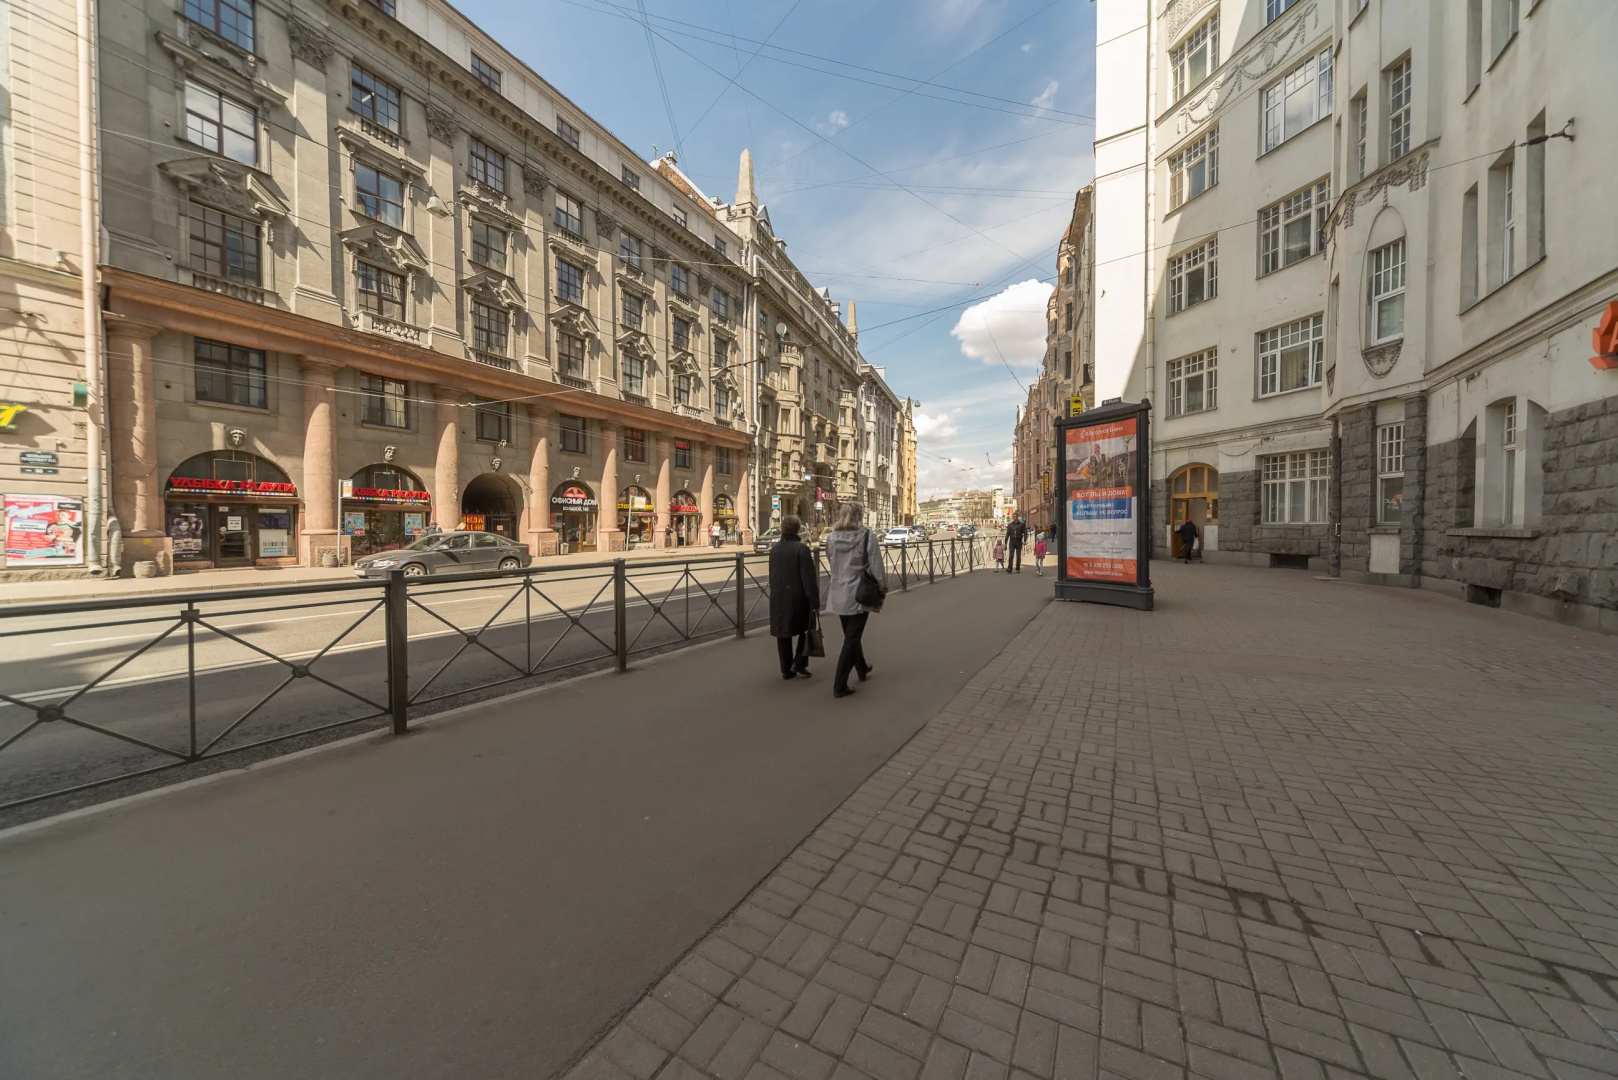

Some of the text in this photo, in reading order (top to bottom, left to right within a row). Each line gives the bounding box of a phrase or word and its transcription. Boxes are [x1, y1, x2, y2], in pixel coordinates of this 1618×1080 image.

[170, 476, 295, 492] УЛЫБКА РАДУГИ
[352, 487, 430, 499] ЛЫБКА РАДУГИ
[551, 496, 583, 505] ОФИСНЫЙ
[583, 499, 597, 507] ДОМ
[1108, 508, 1128, 516] ВОПРОС
